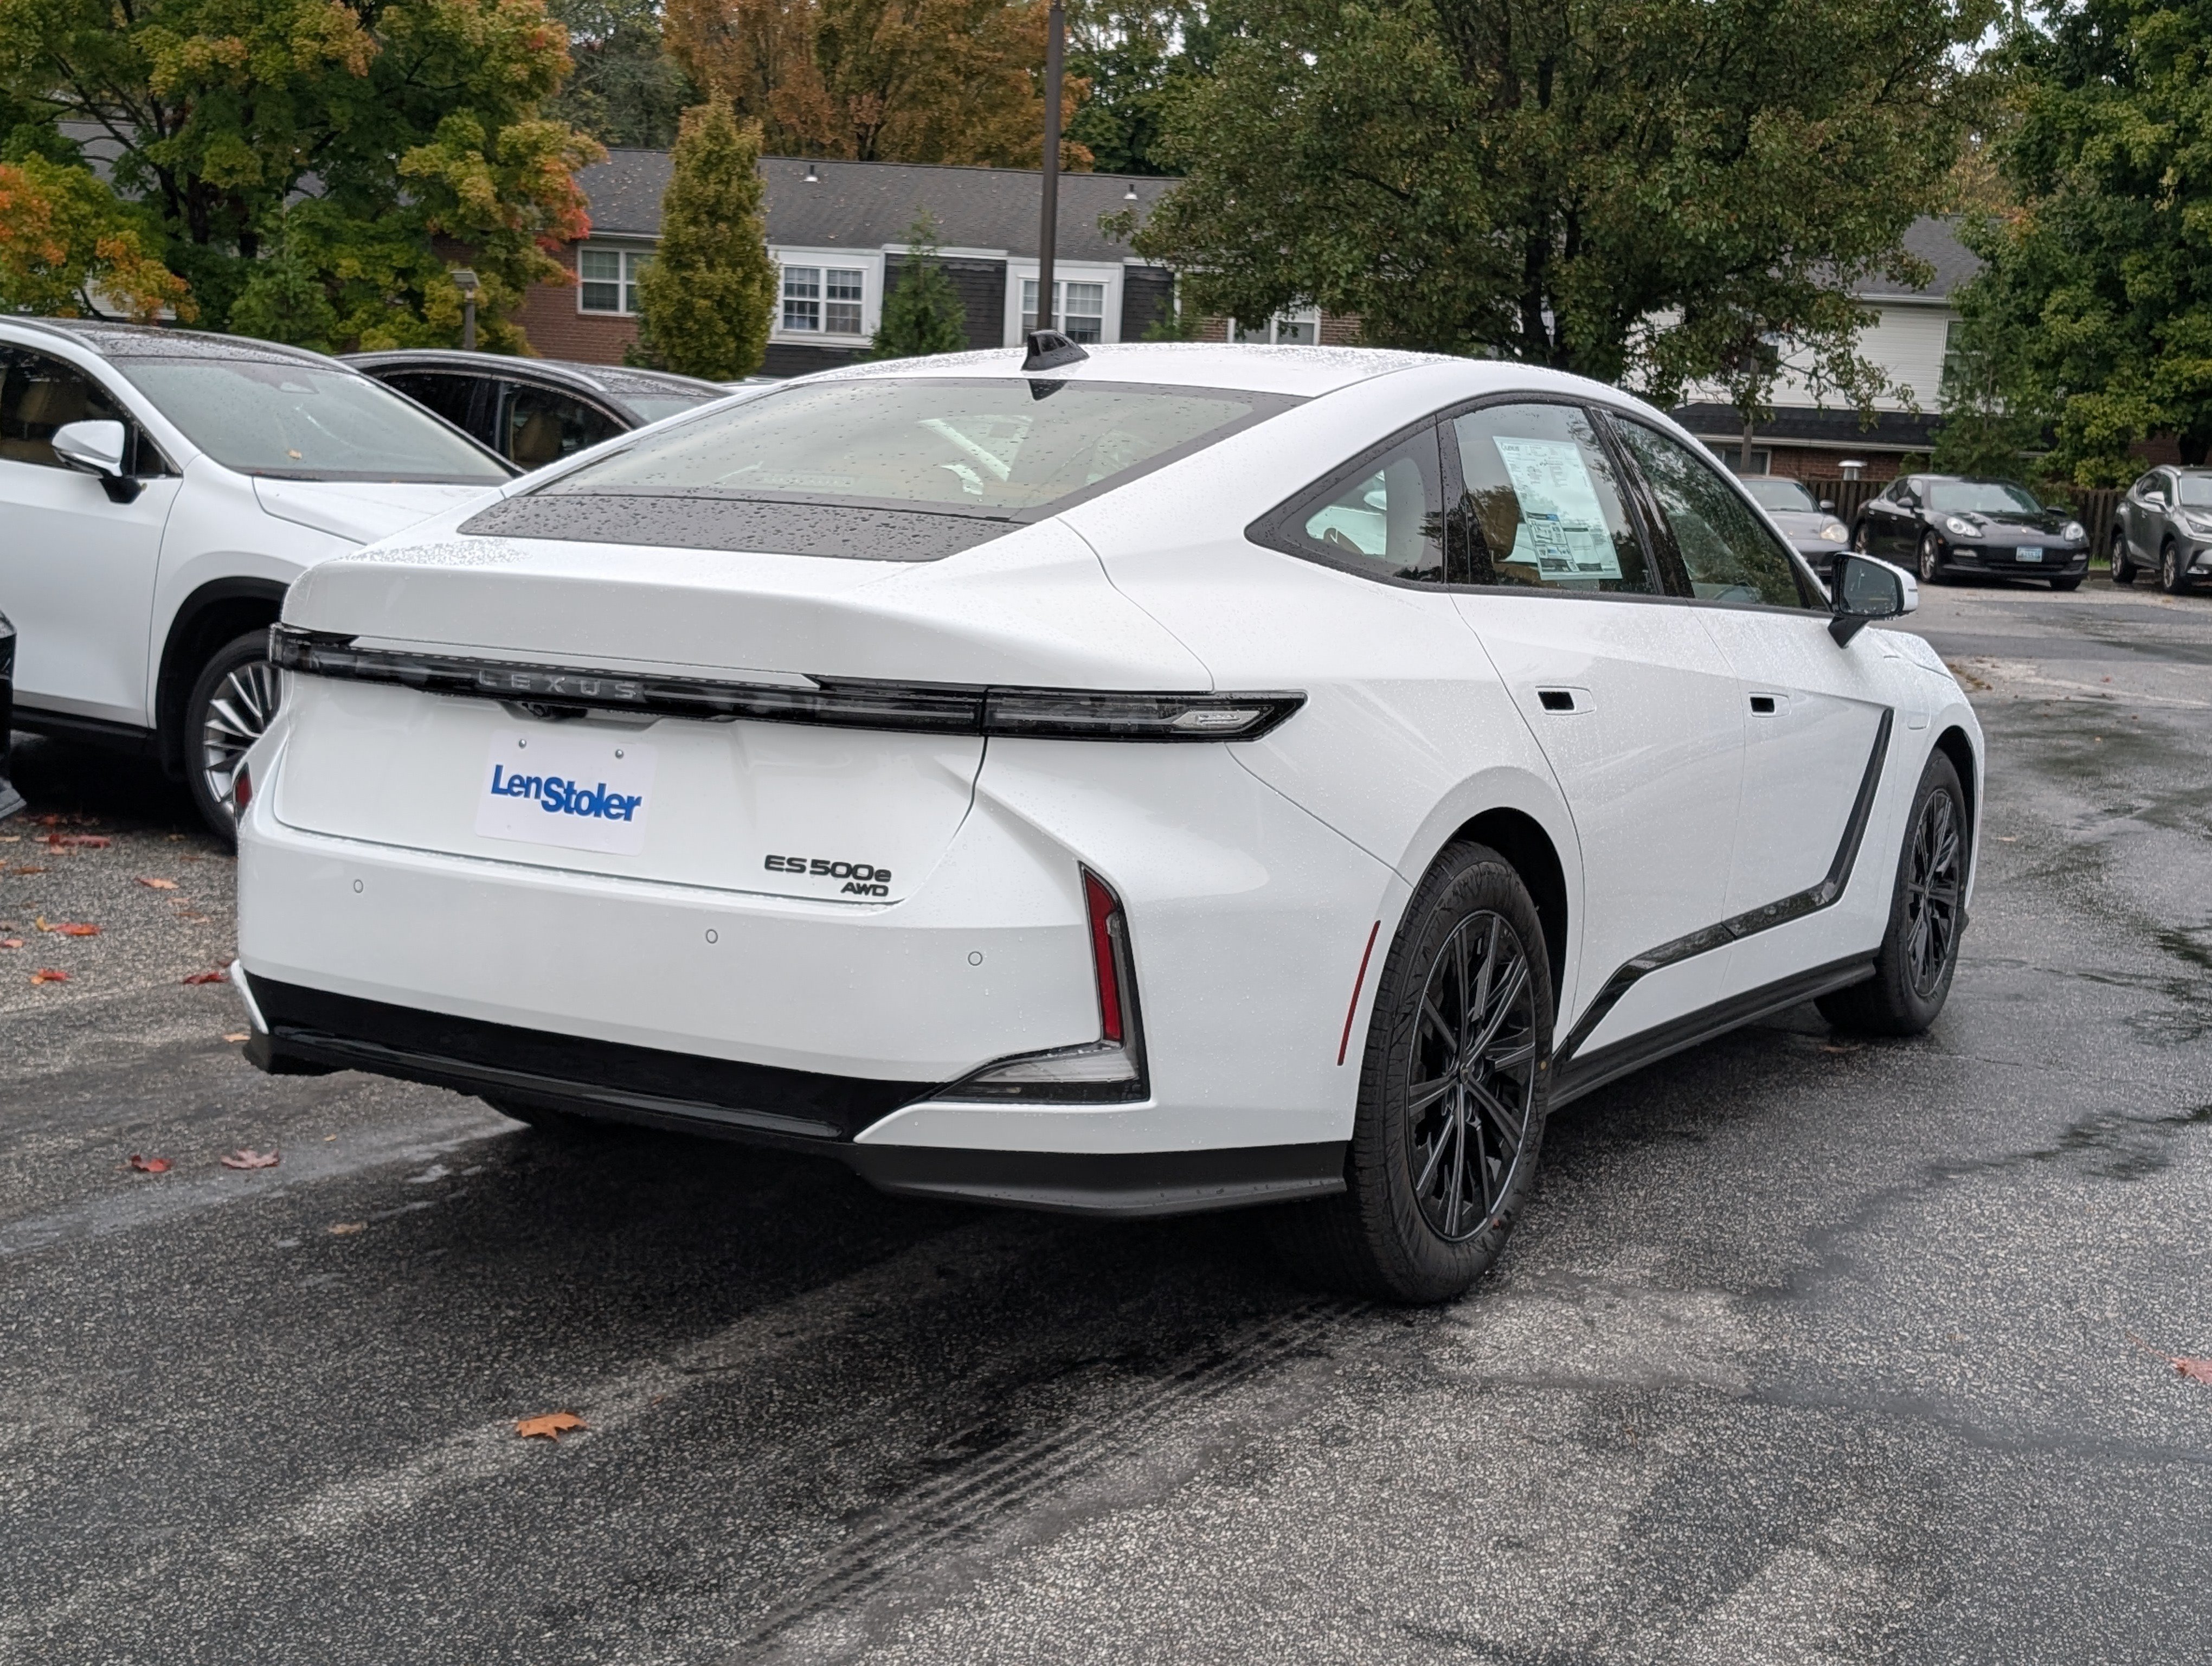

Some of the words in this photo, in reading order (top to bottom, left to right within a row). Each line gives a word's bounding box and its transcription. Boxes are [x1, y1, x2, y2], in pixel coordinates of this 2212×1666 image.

[479, 670, 636, 699] LEXUS
[764, 855, 807, 873] ES
[809, 859, 891, 882] 500e
[840, 882, 889, 897] AWD
